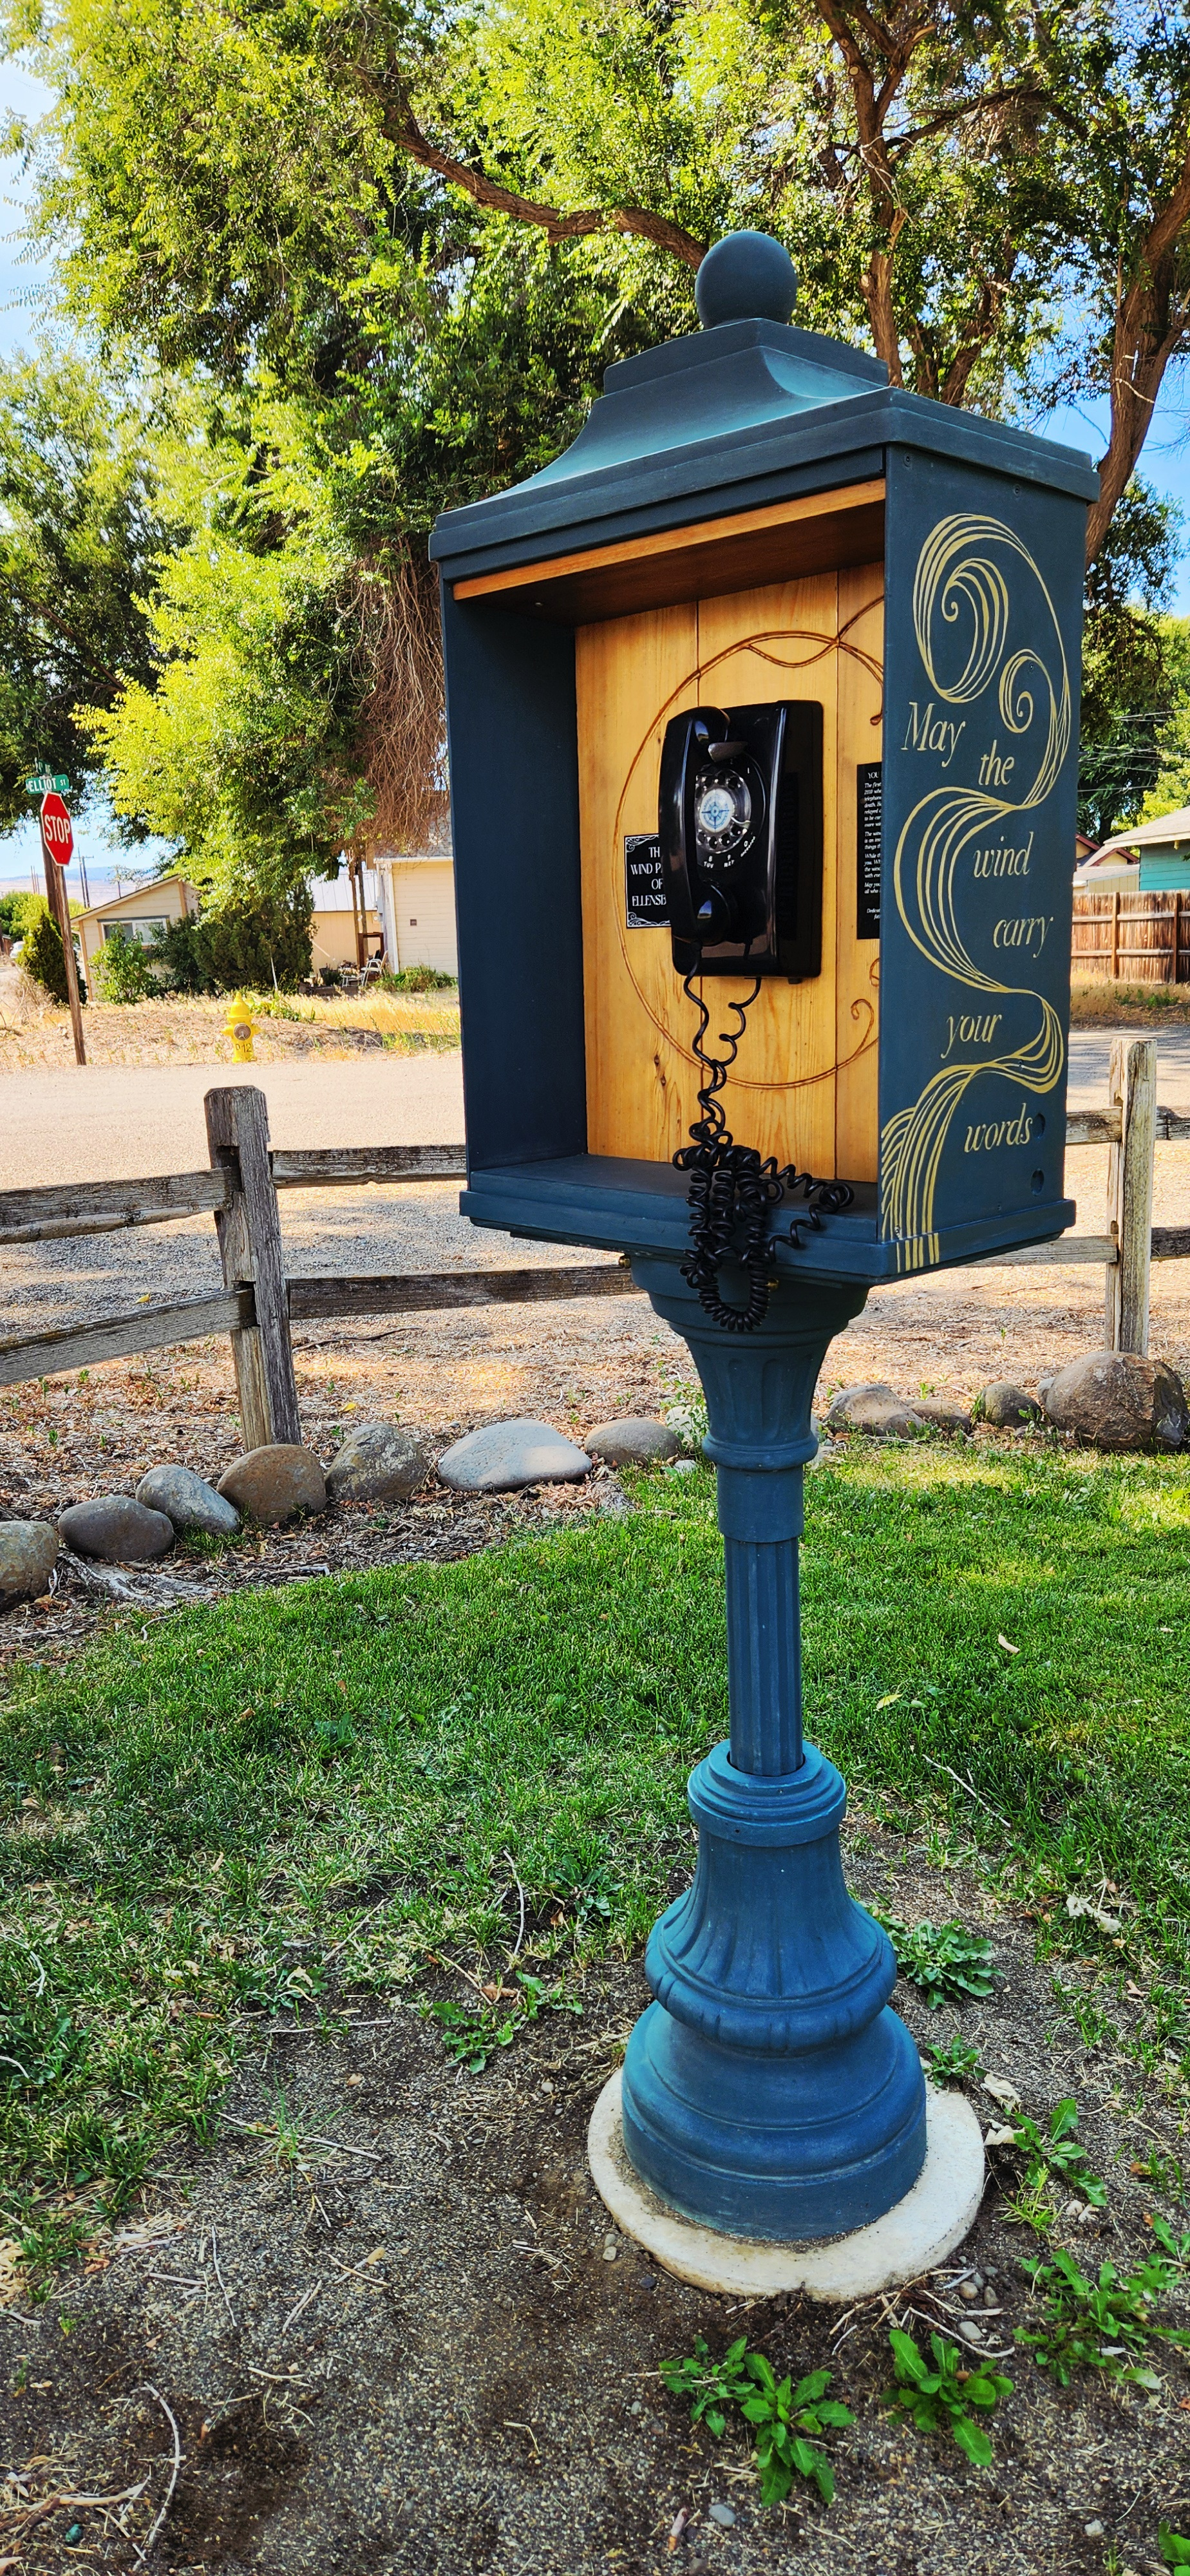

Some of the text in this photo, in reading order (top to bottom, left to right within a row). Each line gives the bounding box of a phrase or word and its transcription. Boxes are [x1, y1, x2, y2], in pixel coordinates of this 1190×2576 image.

[901, 702, 965, 768] May
[978, 740, 1015, 786] the
[28, 777, 57, 792] ELLIOT
[44, 814, 70, 844] STOP
[648, 846, 661, 858] TH
[973, 831, 1034, 878] wind
[630, 863, 653, 875] WIND
[651, 878, 664, 890] OF
[632, 894, 666, 907] ELLENSB
[993, 916, 1053, 958] carry
[241, 1043, 252, 1053] 12
[940, 1014, 1002, 1059] your
[964, 1103, 1033, 1153] words
